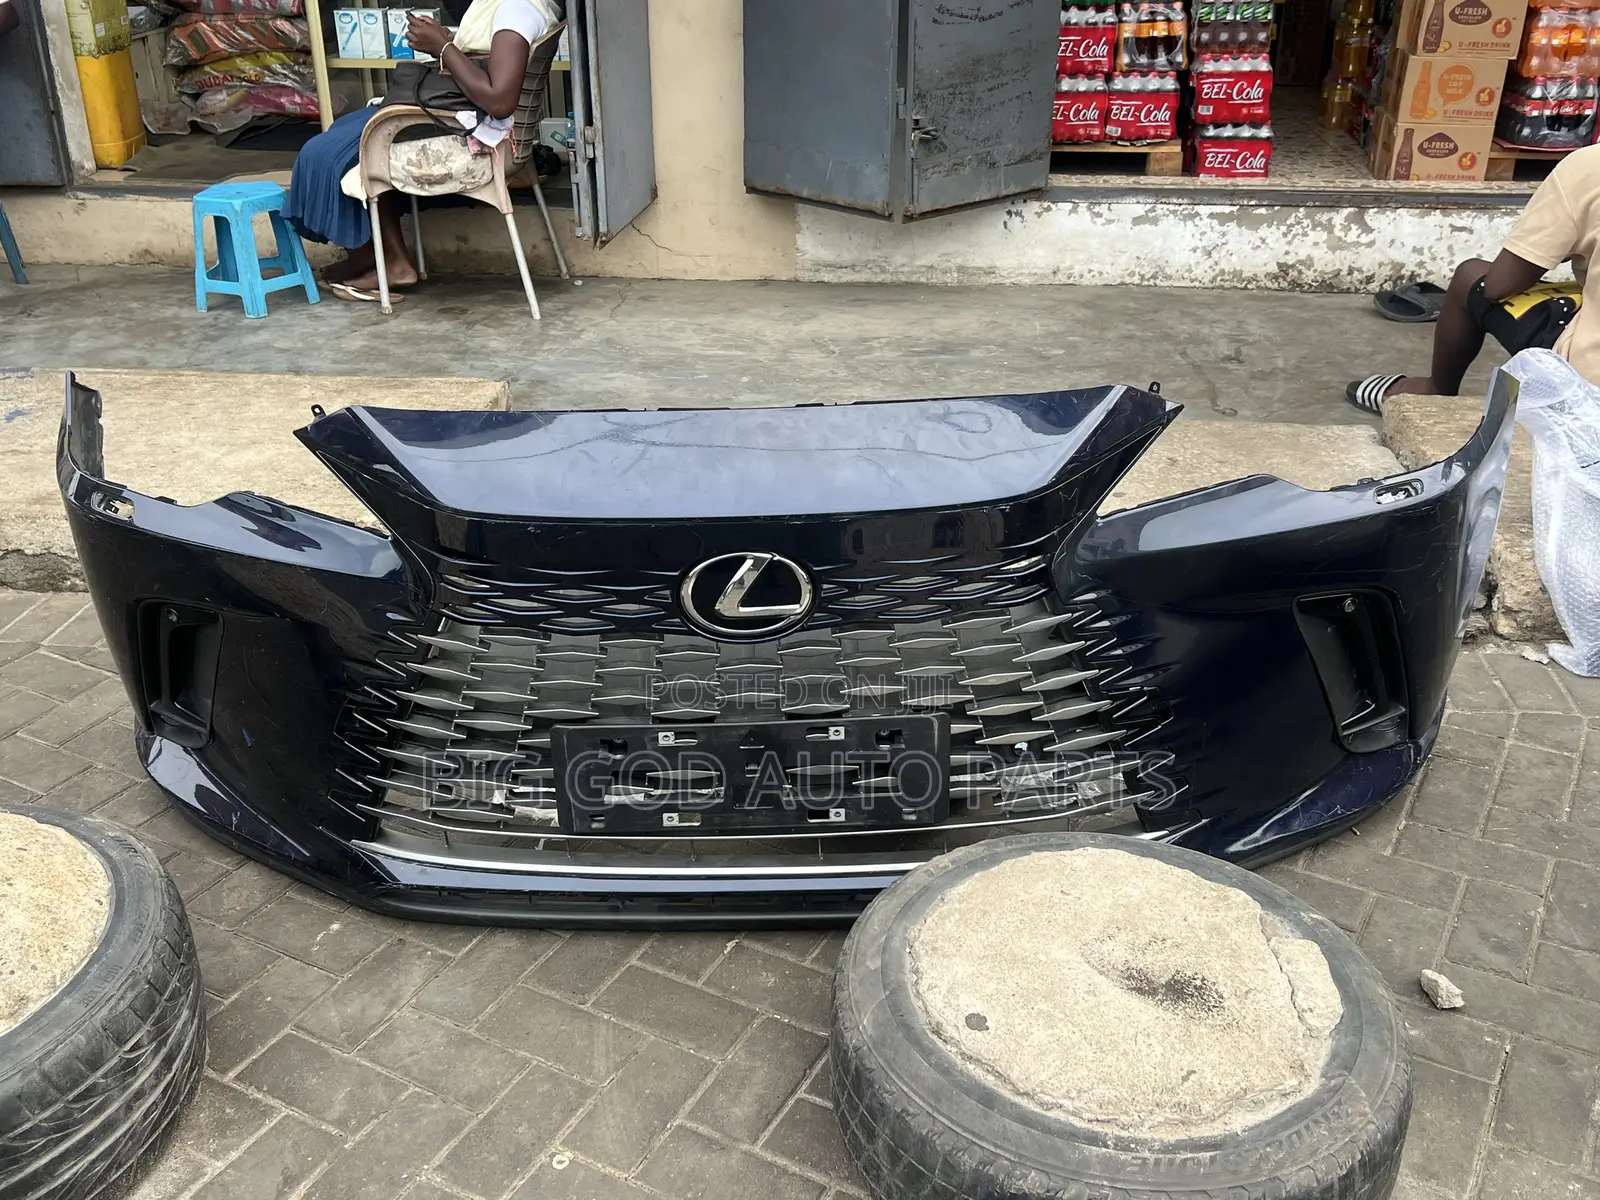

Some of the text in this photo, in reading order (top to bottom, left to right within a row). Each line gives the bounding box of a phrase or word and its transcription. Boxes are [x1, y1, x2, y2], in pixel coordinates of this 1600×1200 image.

[1454, 7, 1488, 16] U-FRESH
[1057, 37, 1109, 58] EL-Cola
[1201, 80, 1265, 101] BEL-Cola
[1052, 101, 1100, 122] EL-Cola
[1110, 102, 1171, 123] BEL-Cola
[1422, 141, 1455, 149] U-FRESH
[1204, 149, 1267, 170] BEL-Cola
